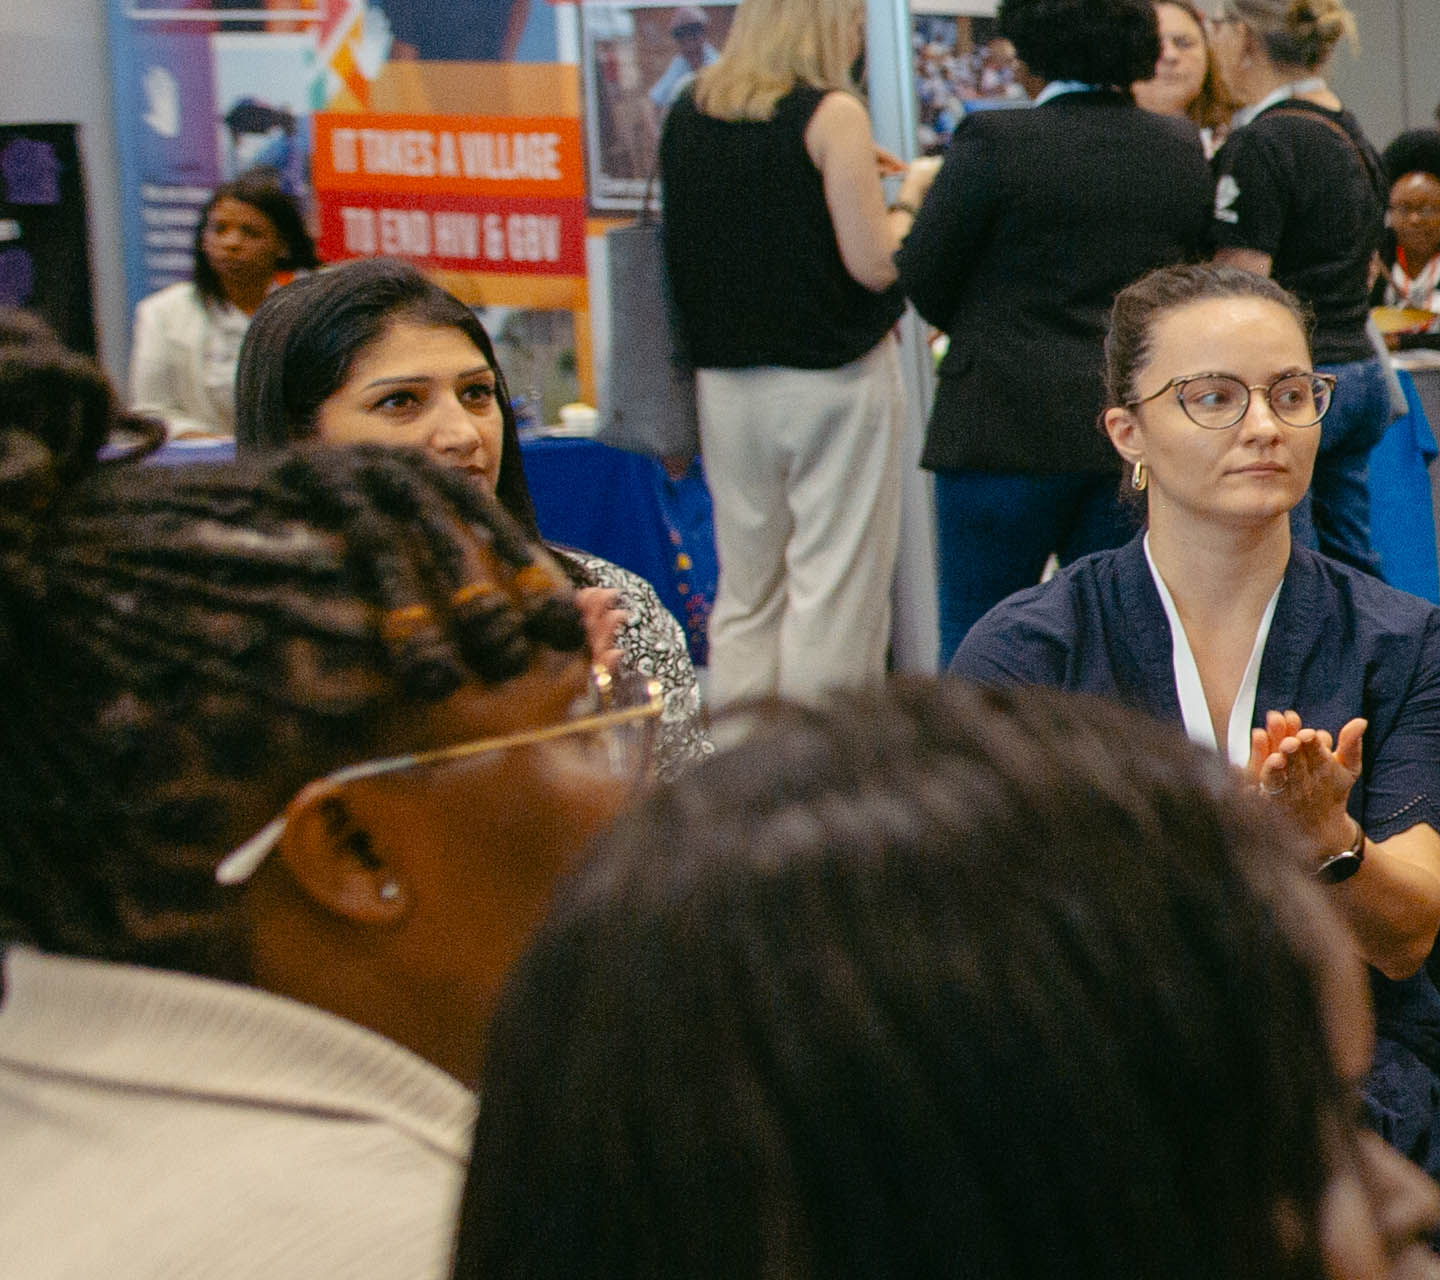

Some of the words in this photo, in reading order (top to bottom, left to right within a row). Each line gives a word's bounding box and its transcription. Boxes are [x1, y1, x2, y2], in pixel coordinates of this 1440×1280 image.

[332, 128, 357, 174] IT
[359, 128, 436, 177] TAKES
[438, 131, 457, 177] A
[459, 131, 563, 180] VILLAGE
[341, 206, 376, 256] TO
[379, 208, 430, 257] END
[433, 211, 479, 259] HIV
[482, 213, 506, 262] &
[507, 214, 562, 263] GBV
